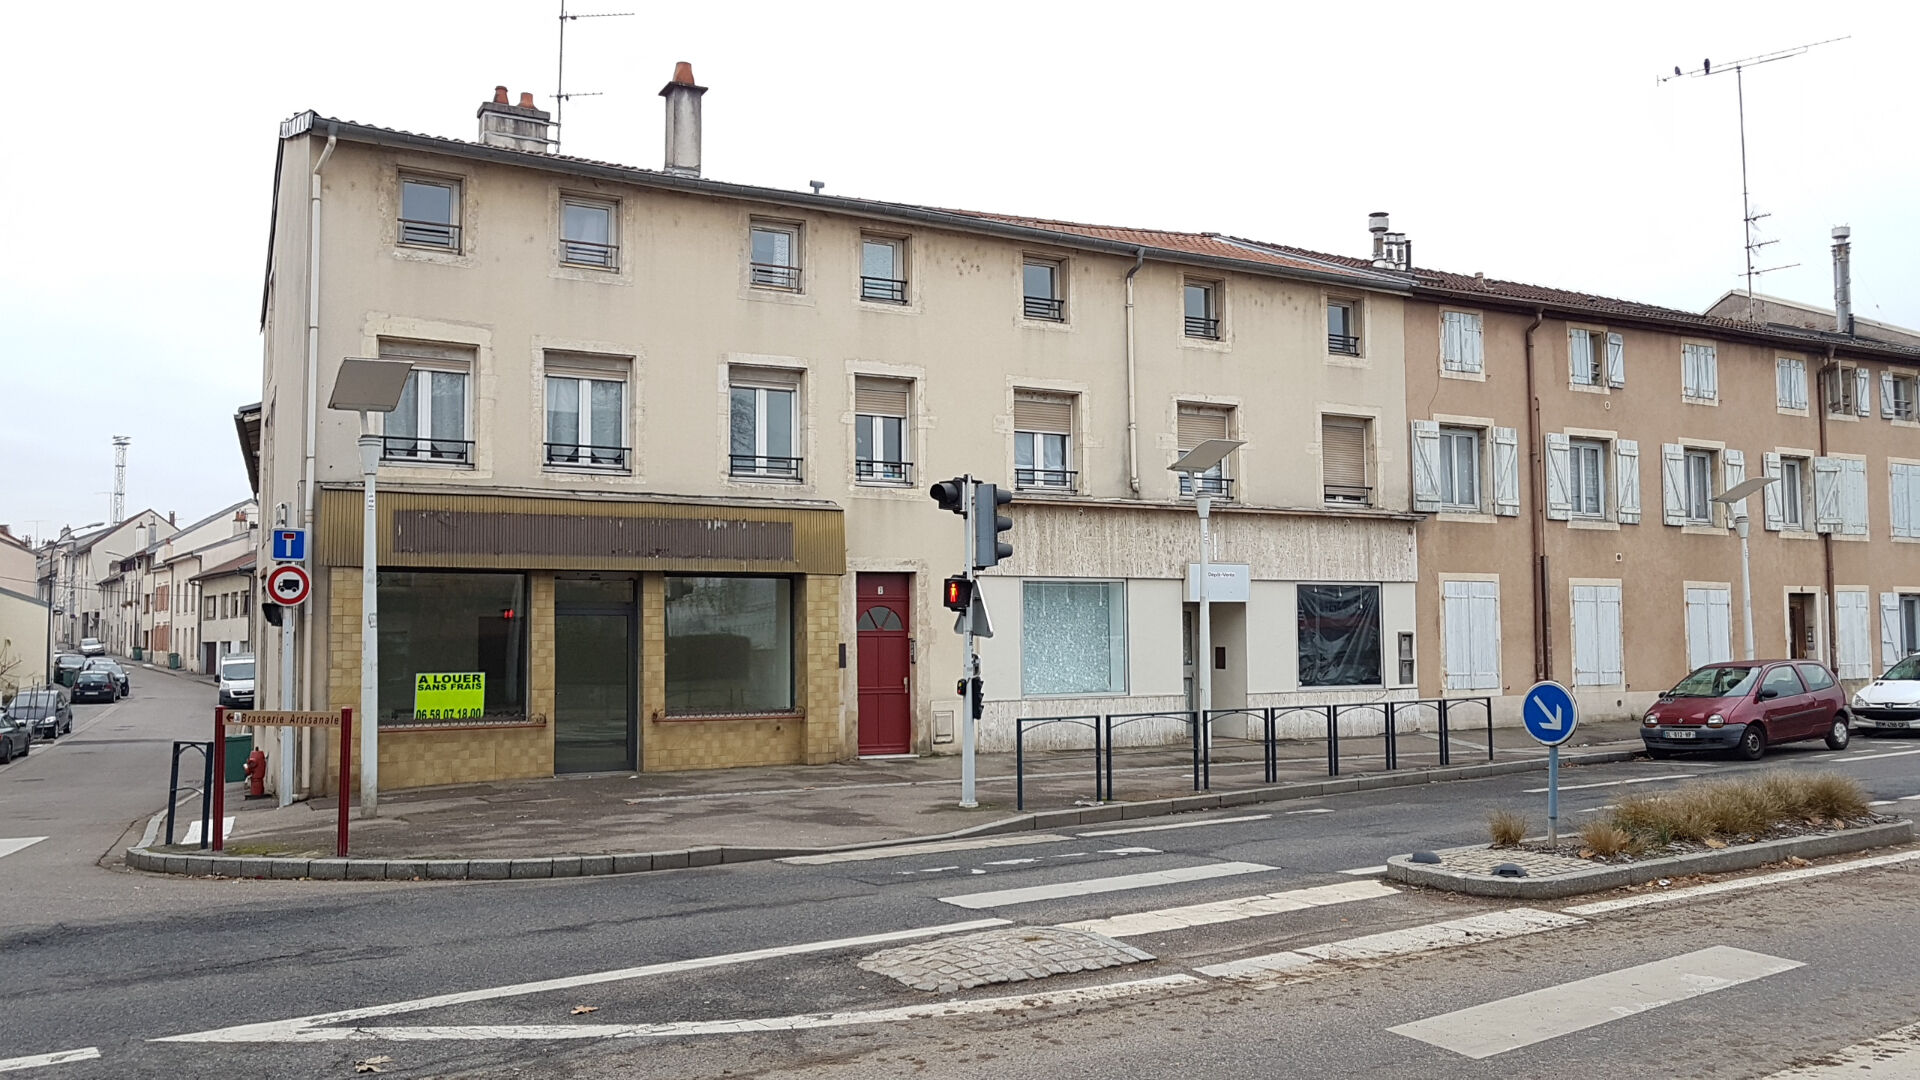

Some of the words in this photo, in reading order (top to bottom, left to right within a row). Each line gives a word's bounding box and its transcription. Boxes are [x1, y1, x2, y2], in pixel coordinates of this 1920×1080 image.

[419, 675, 428, 683] A
[434, 674, 481, 683] LOUER
[242, 713, 284, 723] Brasserie
[289, 714, 339, 725] Artisanale
